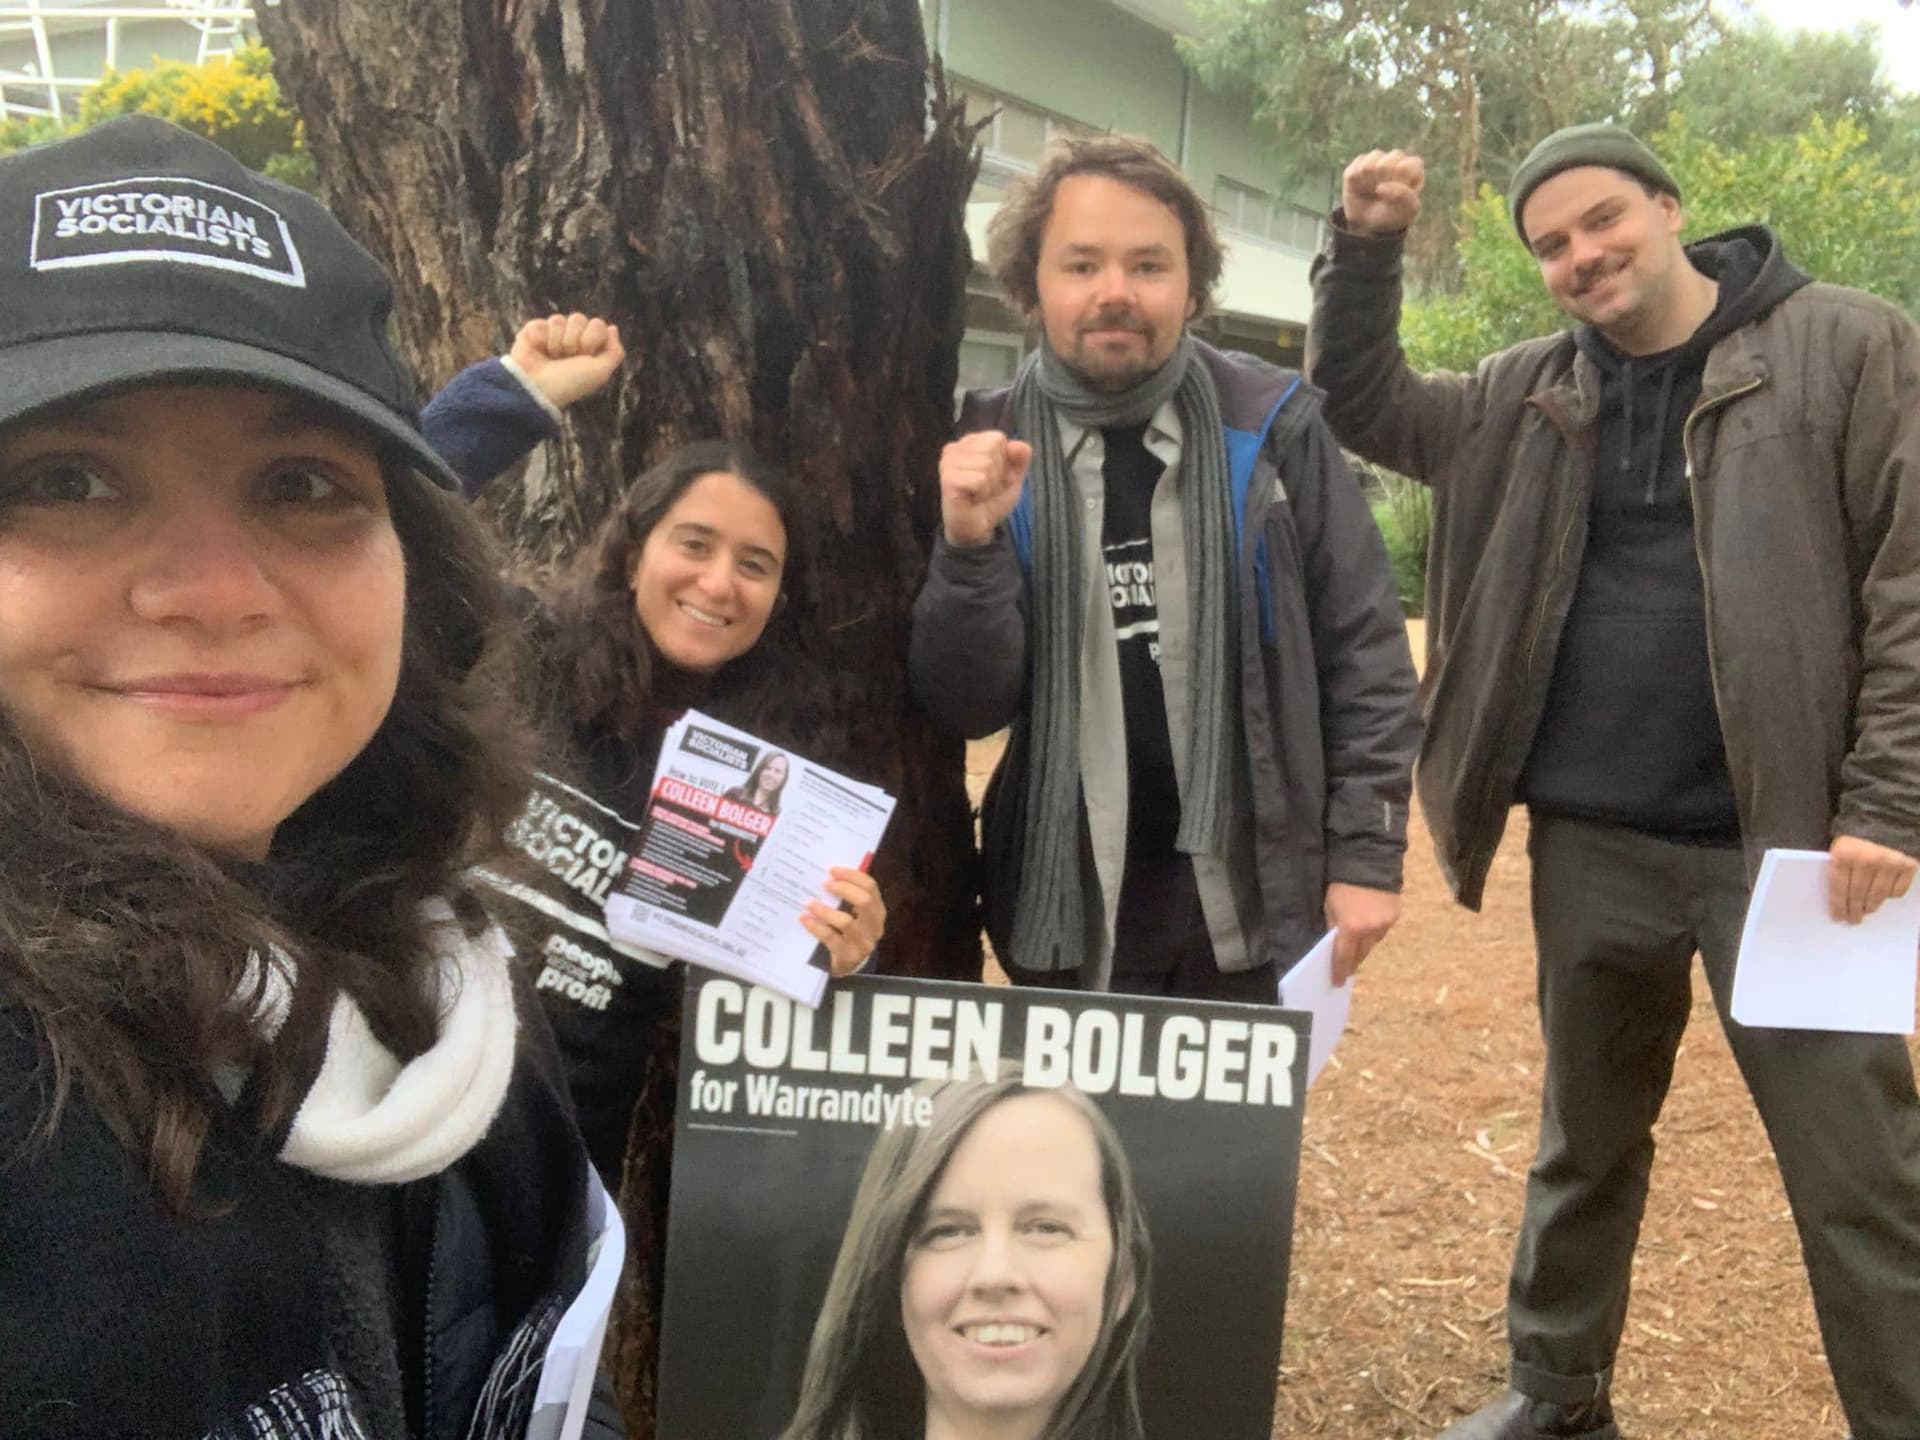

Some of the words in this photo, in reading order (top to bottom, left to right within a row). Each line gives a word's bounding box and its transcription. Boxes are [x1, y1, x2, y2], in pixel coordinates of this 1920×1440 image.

[55, 213, 272, 260] SOCIALISTS
[56, 193, 257, 236] VICTORIAN
[662, 779, 717, 816] COLLEEN
[720, 800, 772, 836] BOLGER
[535, 966, 612, 1011] profit
[695, 979, 1004, 1084] COLLEEN
[1022, 1006, 1298, 1107] BOLGER
[690, 1070, 738, 1113] for
[745, 1073, 934, 1131] Warrandyte
